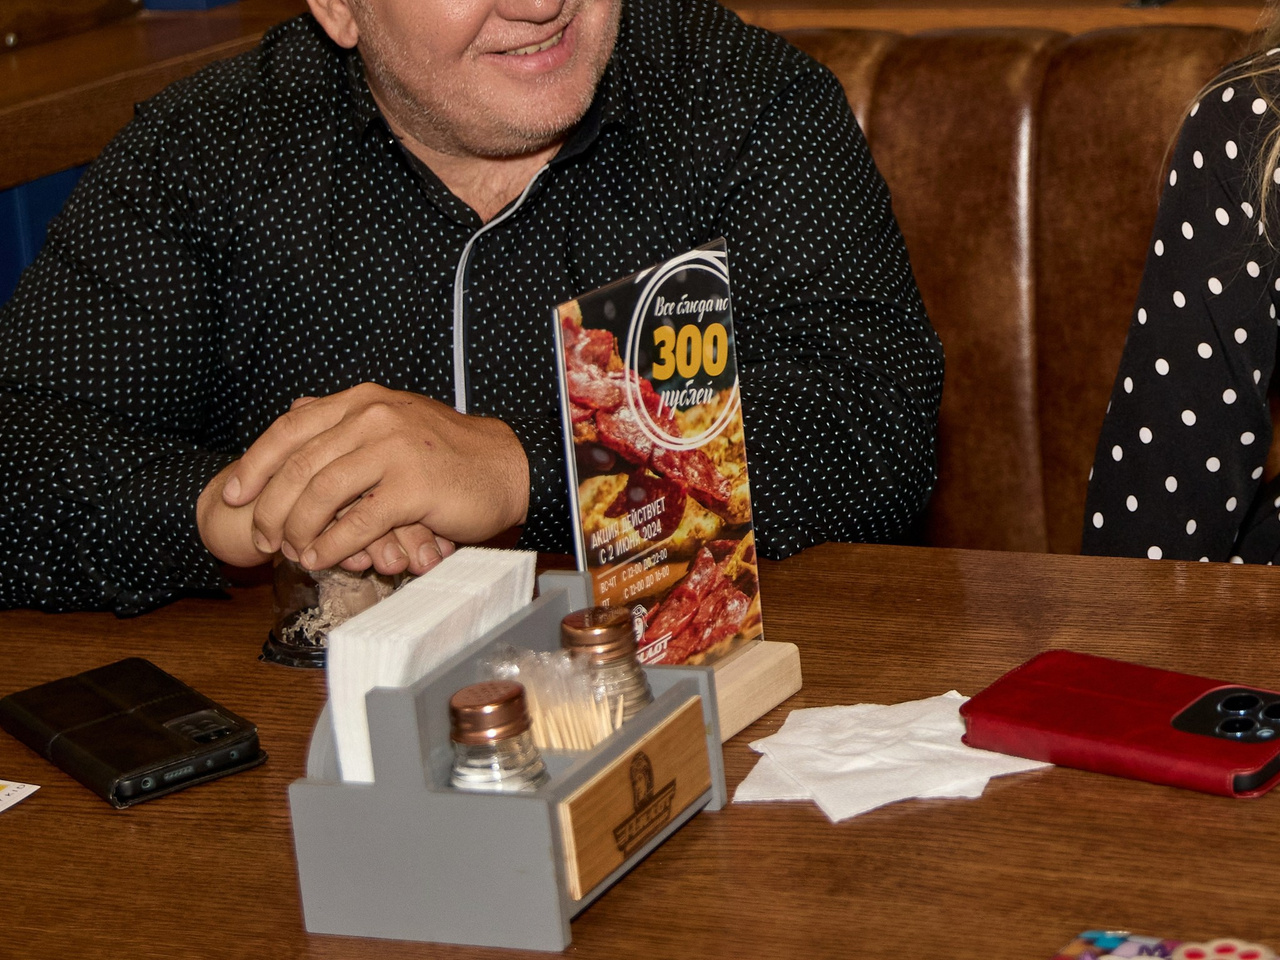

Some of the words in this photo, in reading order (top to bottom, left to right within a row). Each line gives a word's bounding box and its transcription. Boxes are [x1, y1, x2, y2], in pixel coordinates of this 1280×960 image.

[654, 296, 676, 316] Все
[676, 294, 714, 323] блюда
[714, 298, 729, 312] по
[652, 322, 729, 380] 300
[656, 379, 713, 420] рублей
[591, 521, 620, 549] АКЦИЯ
[621, 496, 666, 534] ДЕЙСТВУЕТ
[599, 548, 607, 564] С
[608, 545, 615, 560] 2
[615, 530, 641, 556] ИЮНЯ
[642, 519, 662, 541] 2024
[600, 576, 617, 594] ВС-ЧТ
[645, 574, 655, 588] ДО
